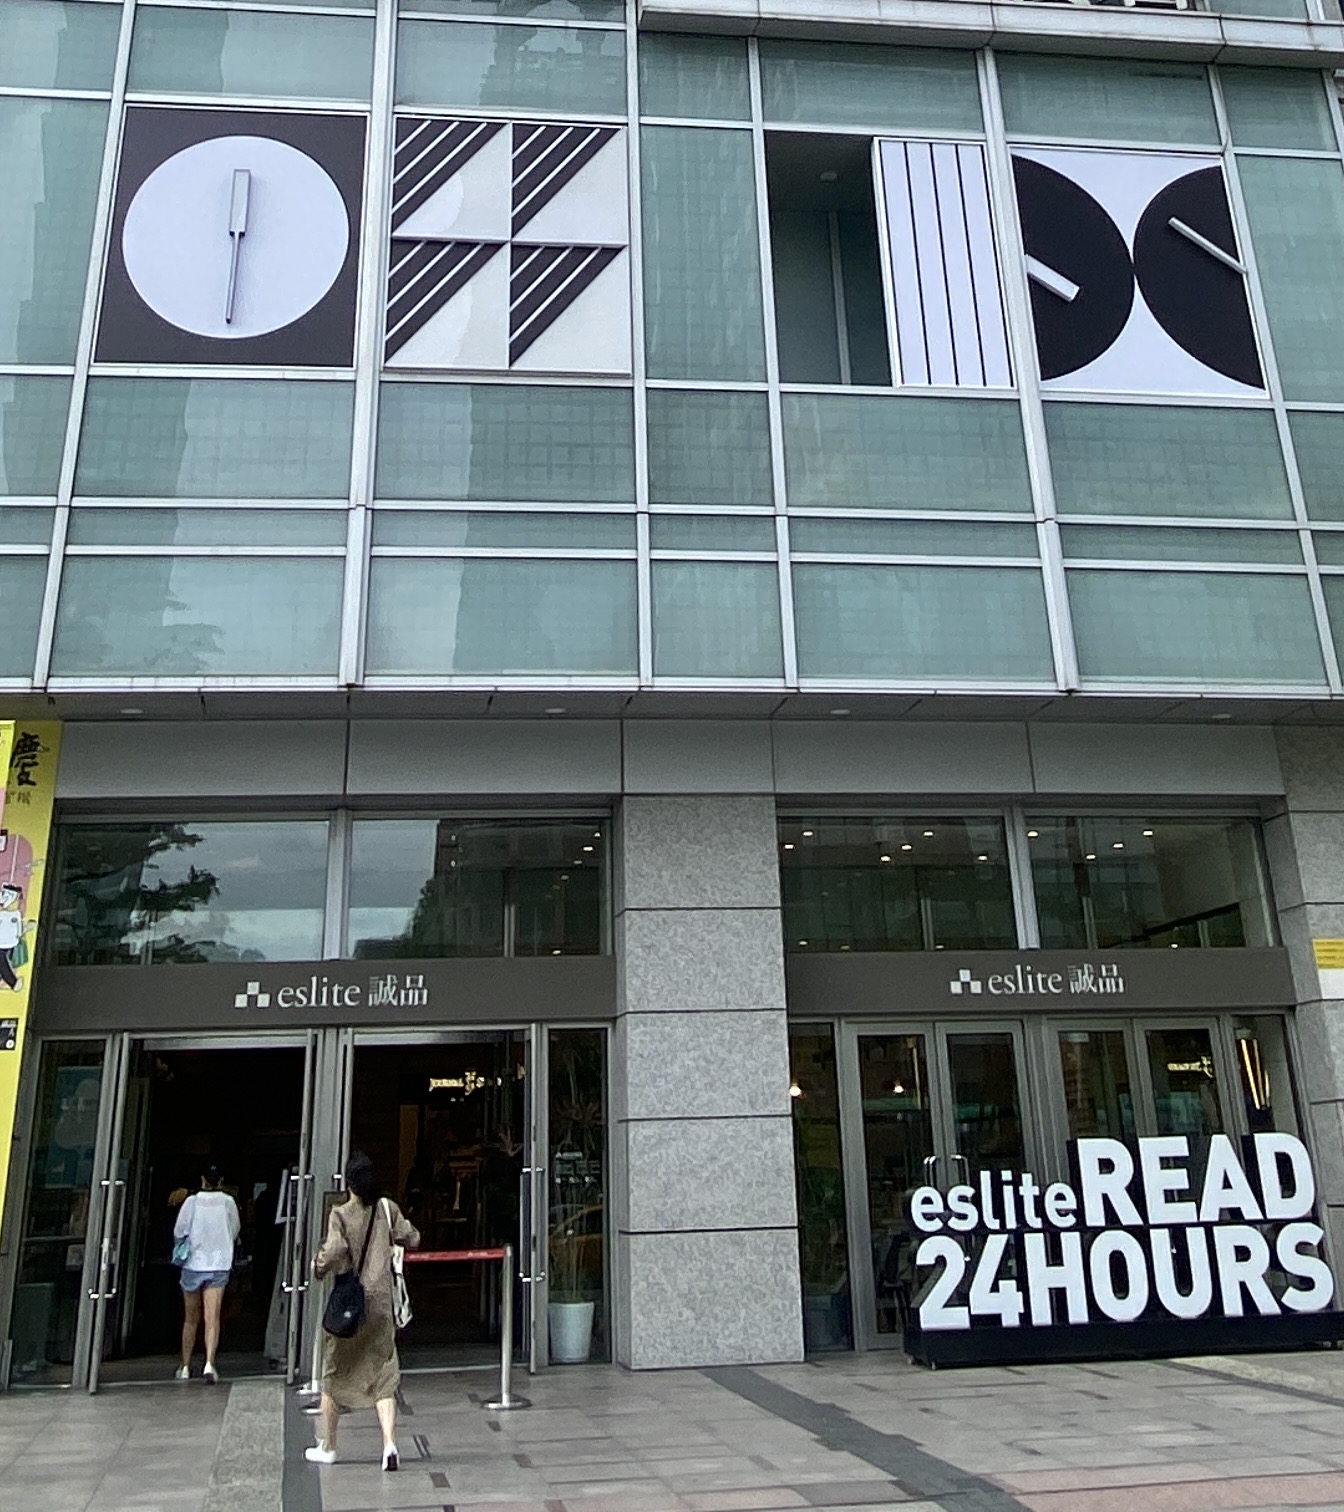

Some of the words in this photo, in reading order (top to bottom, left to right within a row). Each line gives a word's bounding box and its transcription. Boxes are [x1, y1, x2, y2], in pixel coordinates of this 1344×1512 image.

[277, 975, 361, 1009] eslite
[368, 974, 429, 1007] 誠品
[988, 964, 1063, 995] eslite
[1068, 963, 1126, 994] 誠品
[911, 1170, 1077, 1232] eslite
[1077, 1132, 1315, 1227] READ
